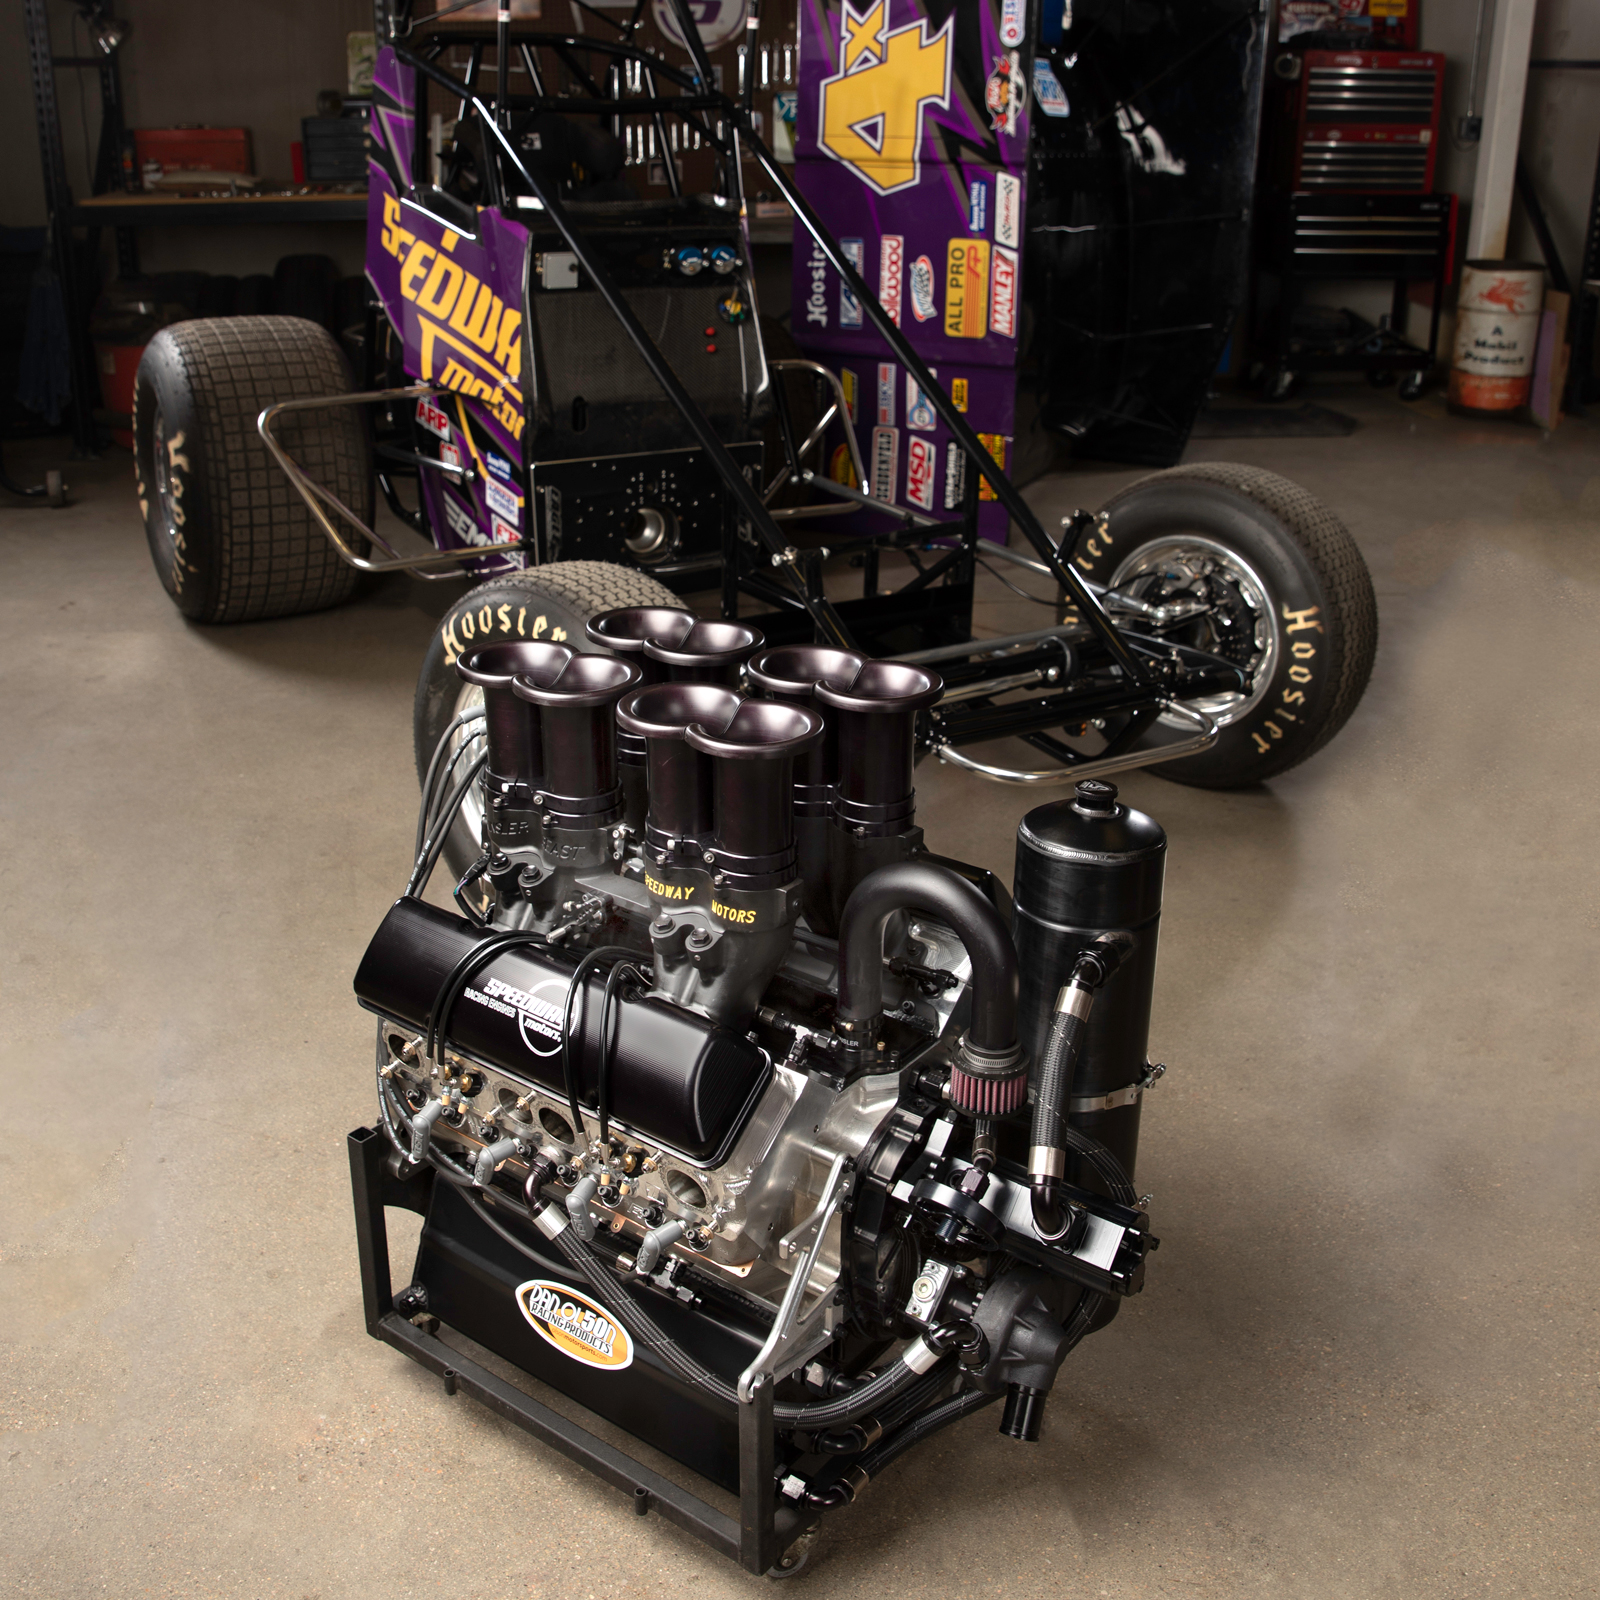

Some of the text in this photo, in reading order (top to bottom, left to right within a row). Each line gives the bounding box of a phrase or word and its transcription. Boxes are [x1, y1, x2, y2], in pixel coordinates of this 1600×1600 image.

[948, 247, 965, 333] ALL PRO
[993, 260, 1013, 334] MANLEY
[1463, 351, 1525, 365] Product
[1474, 338, 1518, 351] Mobil
[418, 401, 448, 432] ARP
[908, 441, 925, 501] MSD
[441, 602, 567, 667] Hoosier
[1252, 603, 1324, 754] Hoosier
[711, 899, 757, 924] MOTORS
[530, 1284, 560, 1313] DAN
[531, 1302, 612, 1354] RACING PRODUCTS
